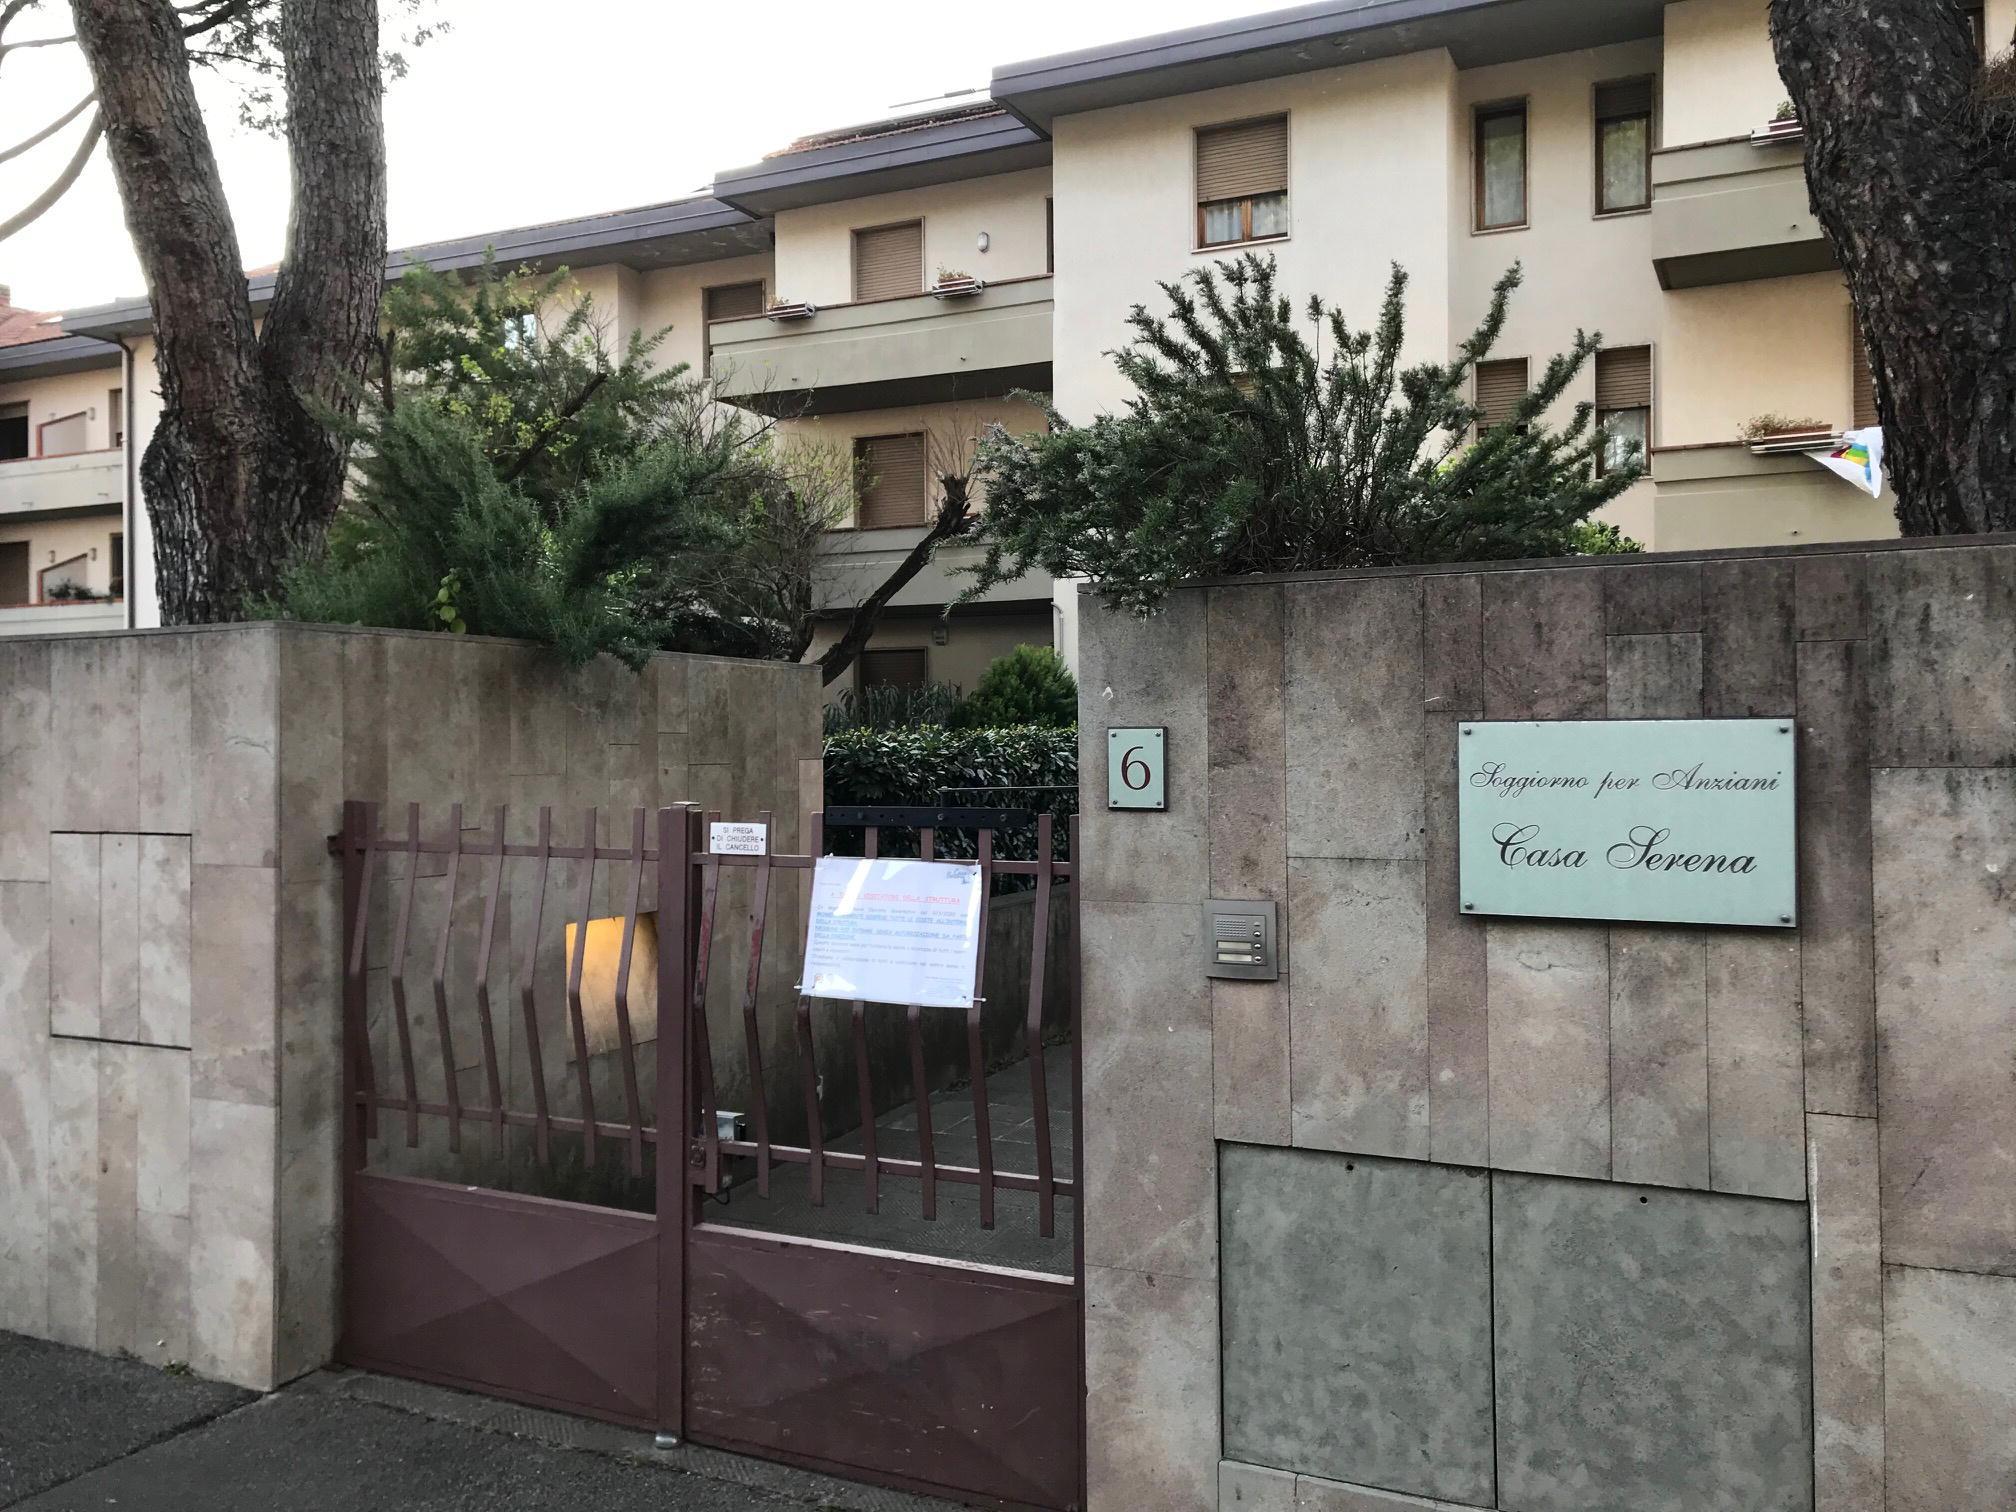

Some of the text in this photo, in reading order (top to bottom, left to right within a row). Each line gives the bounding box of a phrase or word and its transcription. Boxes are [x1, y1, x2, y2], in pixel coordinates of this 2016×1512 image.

[1121, 746, 1151, 790] 6
[1469, 761, 1782, 799] Soggiorno per Anziani
[726, 835, 759, 843] CHIUDERE
[1491, 822, 1758, 875] Casa Serena
